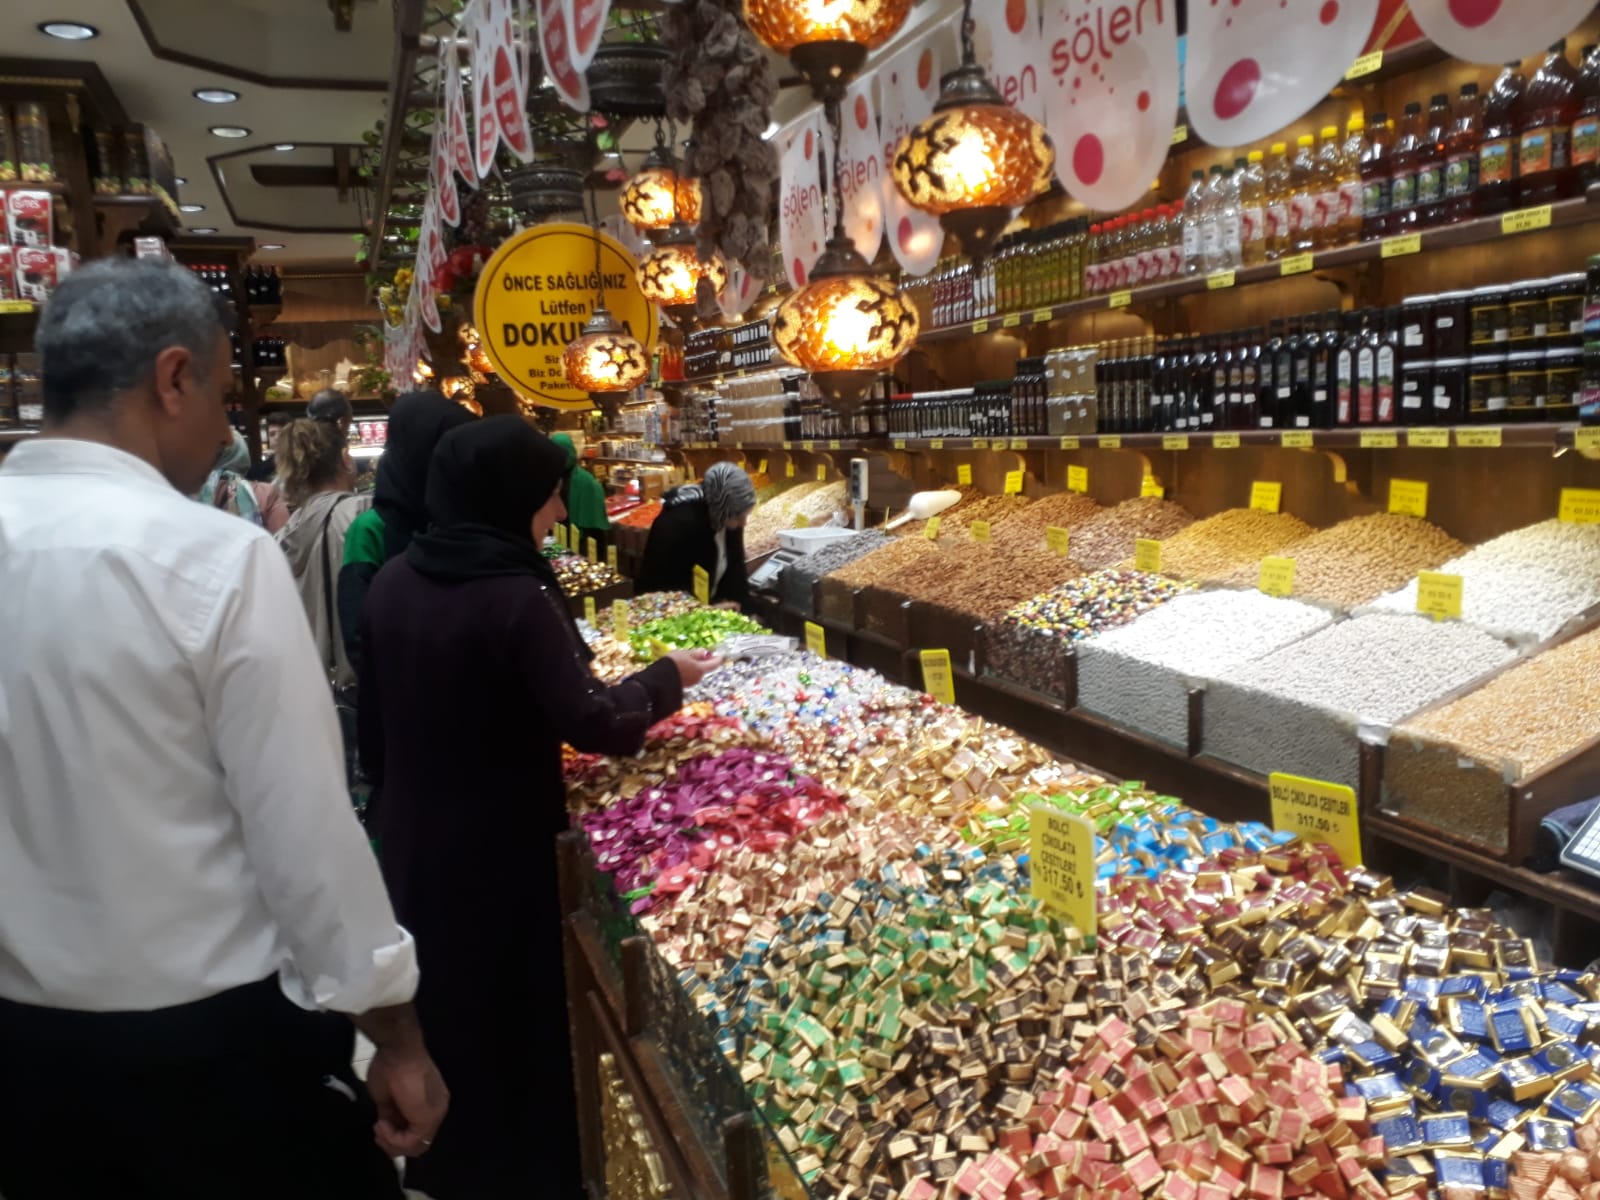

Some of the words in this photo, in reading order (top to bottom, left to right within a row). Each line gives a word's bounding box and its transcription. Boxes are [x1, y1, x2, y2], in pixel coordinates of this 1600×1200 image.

[503, 272, 542, 291] ÖNCE
[547, 271, 627, 291] SAĞLIĞNIZ
[540, 300, 586, 316] Lütfen
[503, 321, 634, 348] DOKUA
[528, 368, 546, 378] Biz
